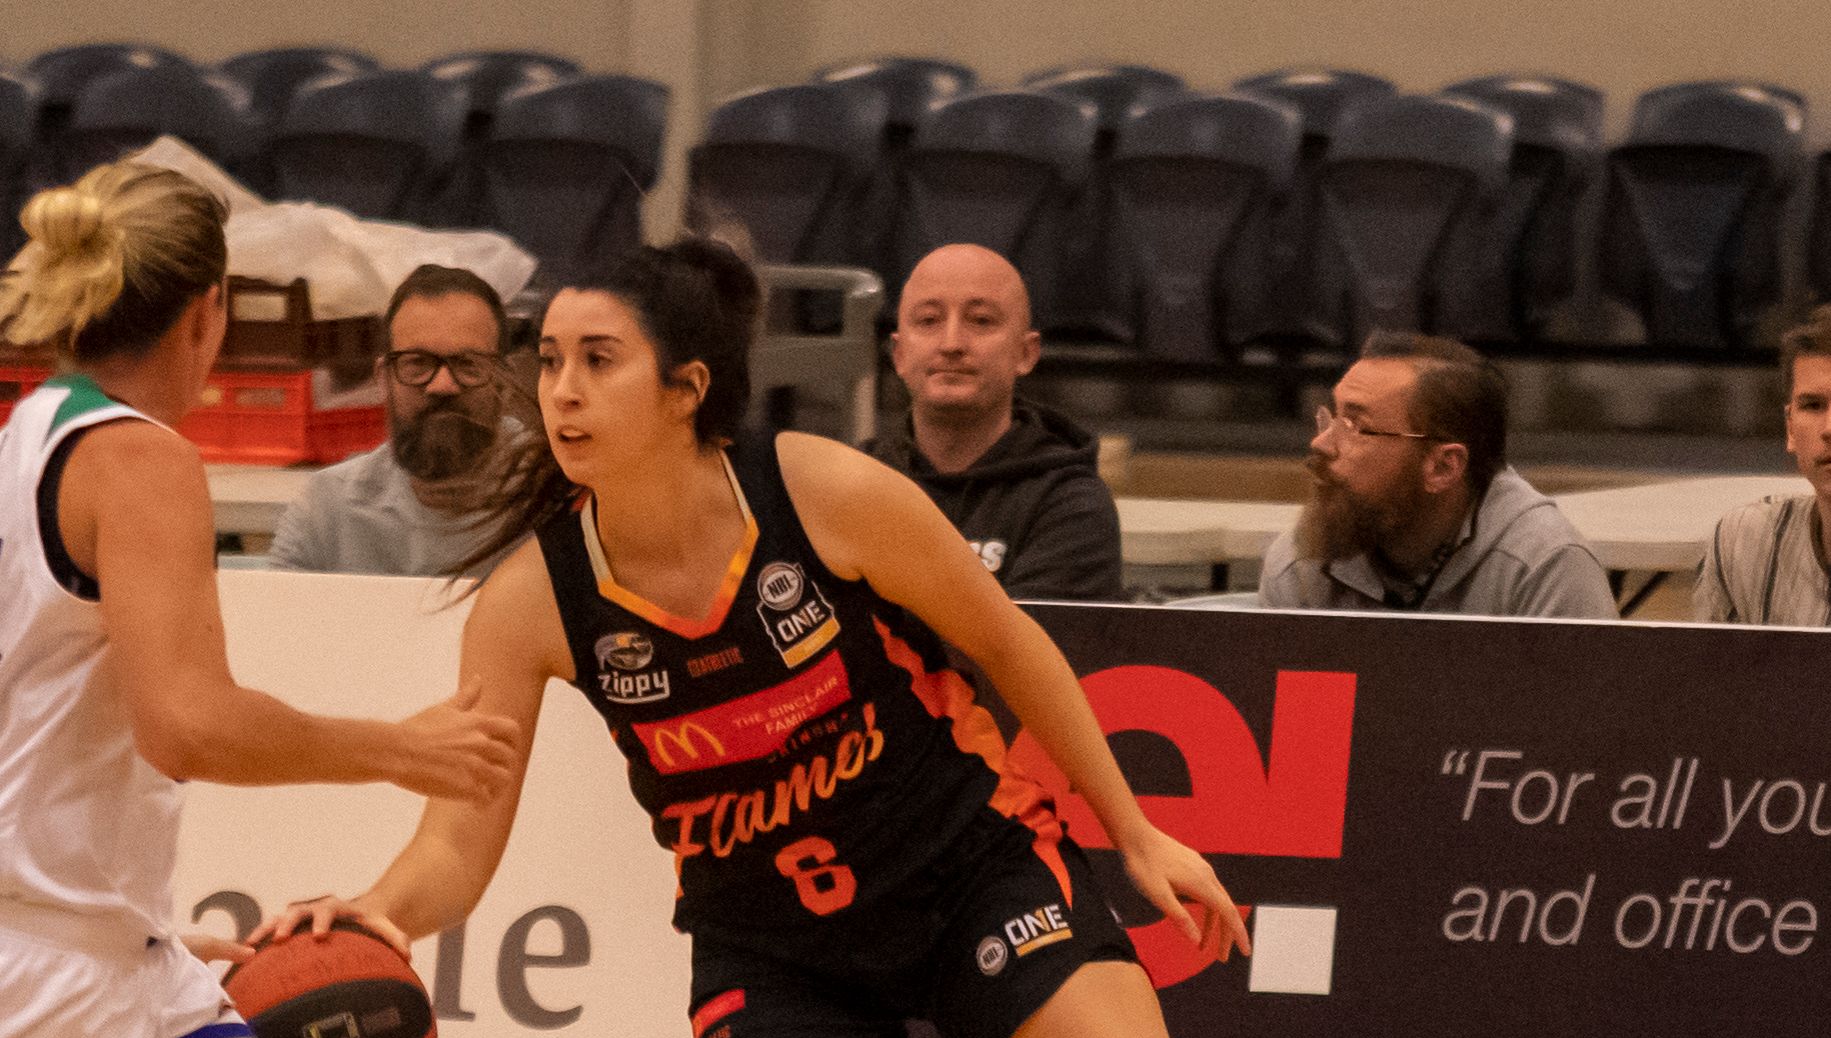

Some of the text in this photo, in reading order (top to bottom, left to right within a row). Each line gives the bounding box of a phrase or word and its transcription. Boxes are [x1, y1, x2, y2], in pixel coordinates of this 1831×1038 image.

[777, 600, 826, 642] ONE
[597, 670, 670, 704] zippy
[733, 676, 838, 729] THE SINCLAIR
[1609, 757, 1699, 829] all
[775, 835, 857, 916] 6
[1004, 904, 1069, 947] ONE
[1442, 873, 1818, 956] and office
